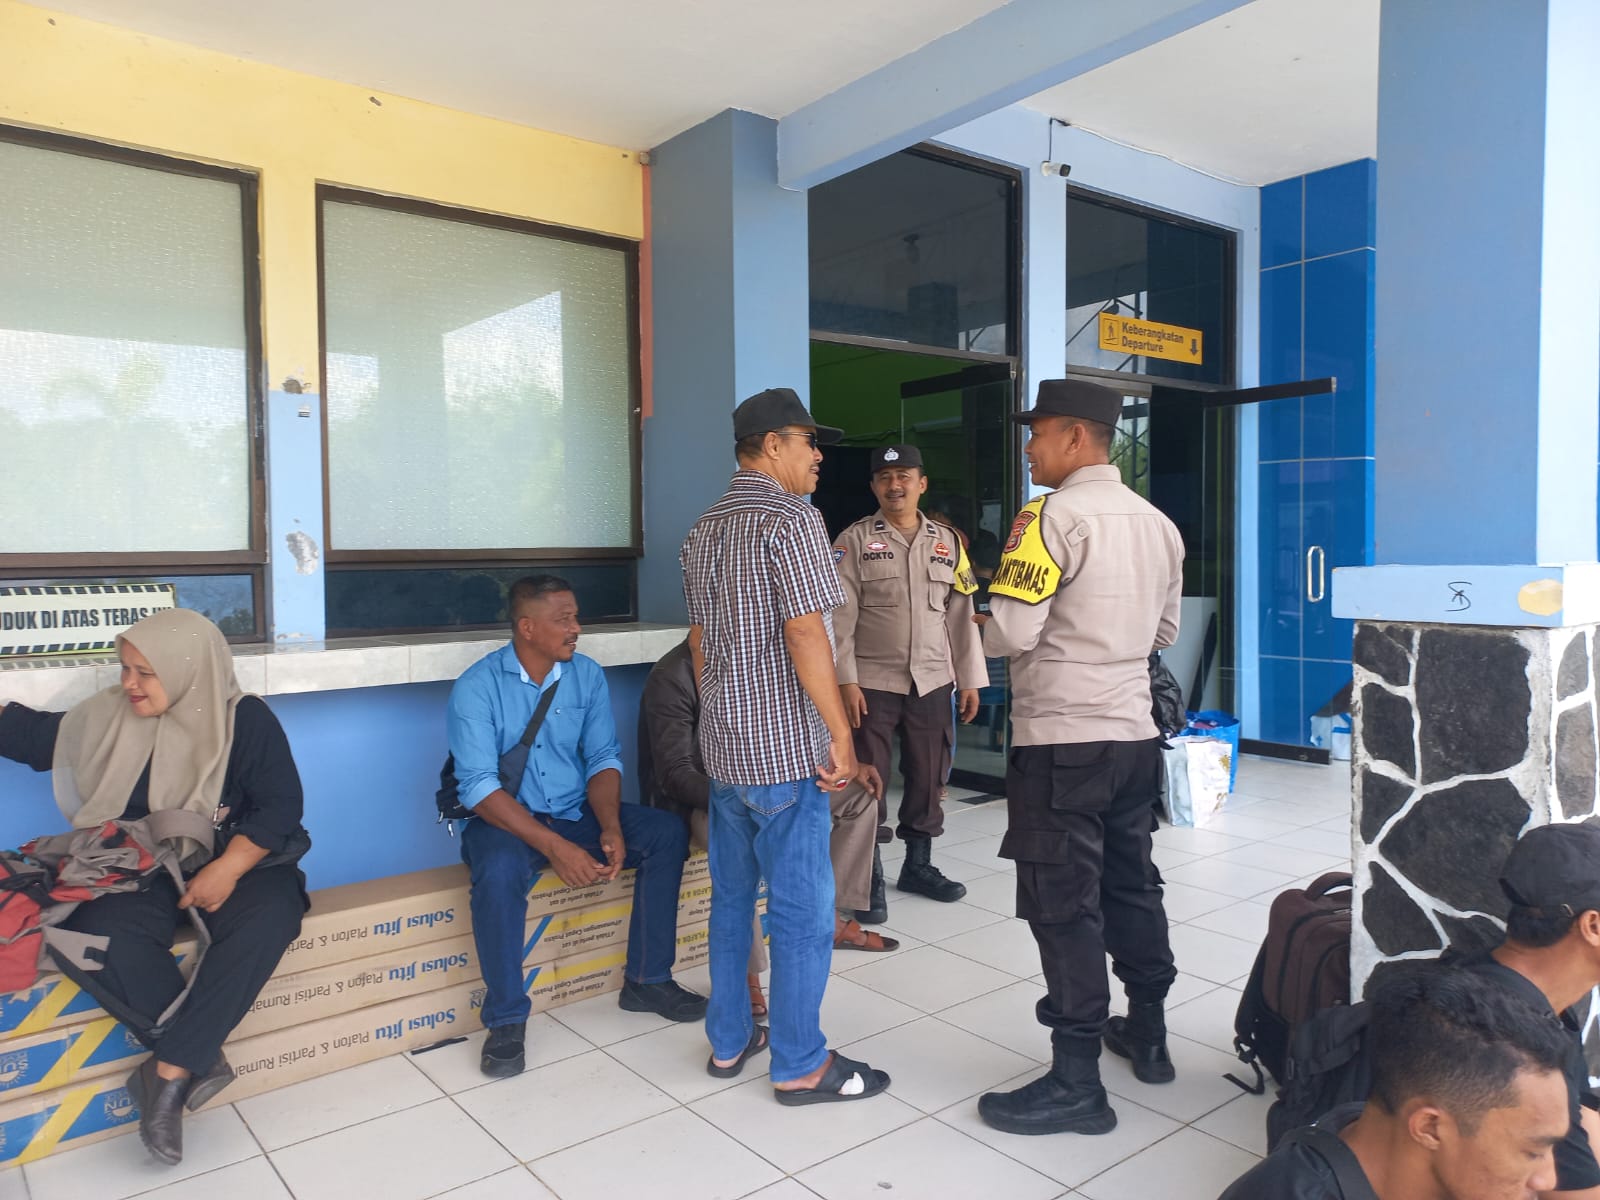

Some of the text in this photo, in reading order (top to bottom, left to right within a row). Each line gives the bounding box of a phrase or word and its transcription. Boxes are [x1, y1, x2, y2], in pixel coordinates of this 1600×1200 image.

[1122, 321, 1184, 344] Keberangkatan
[1122, 336, 1164, 353] Departure
[0, 607, 149, 631] DUK DI ATAS TERAS
[287, 908, 455, 955] Solusi Jitu Plafon & Parti
[388, 961, 417, 983] Jitu
[421, 952, 469, 973] Solusi
[335, 981, 344, 993] &
[347, 971, 383, 990] Plafon
[293, 984, 331, 1004] Partisi
[408, 1008, 456, 1030] Solusi
[333, 1031, 370, 1050] Plafon
[375, 1018, 404, 1042] Jitu
[278, 1045, 316, 1067] Partisi
[319, 1042, 330, 1055] &
[104, 1097, 131, 1113] UN
